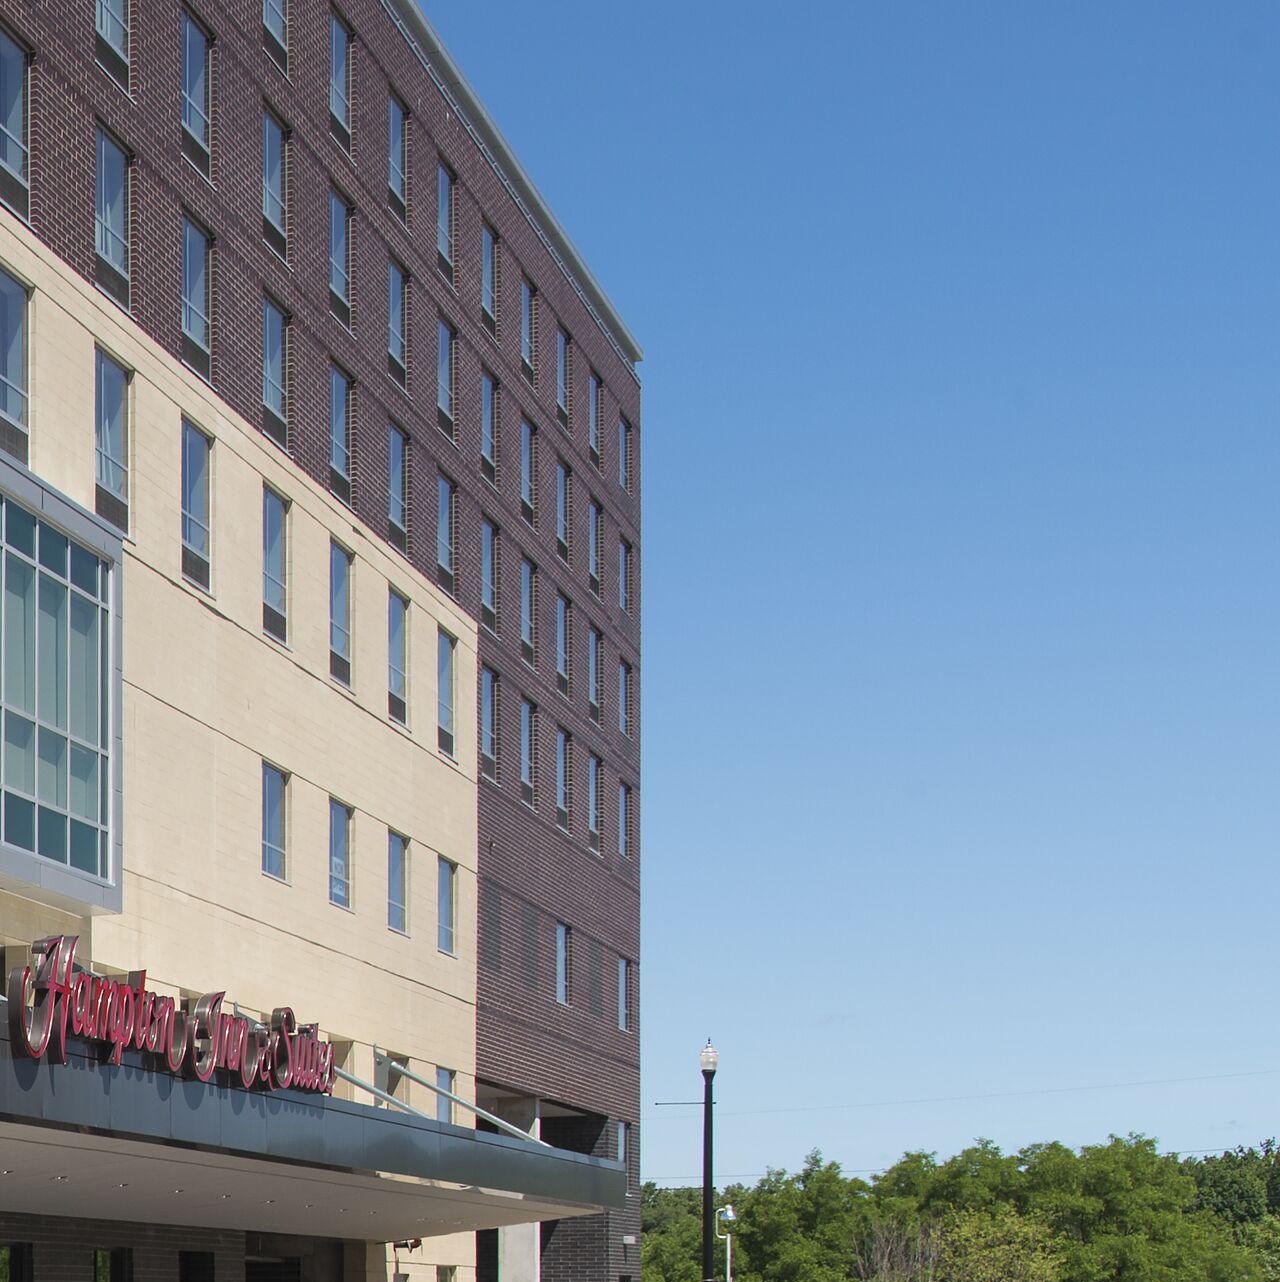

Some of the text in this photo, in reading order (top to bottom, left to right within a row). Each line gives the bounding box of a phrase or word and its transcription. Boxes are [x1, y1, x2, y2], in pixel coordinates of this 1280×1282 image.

[9, 934, 188, 1073] Hampton
[192, 990, 259, 1088] Inn
[272, 1006, 335, 1097] Suites
